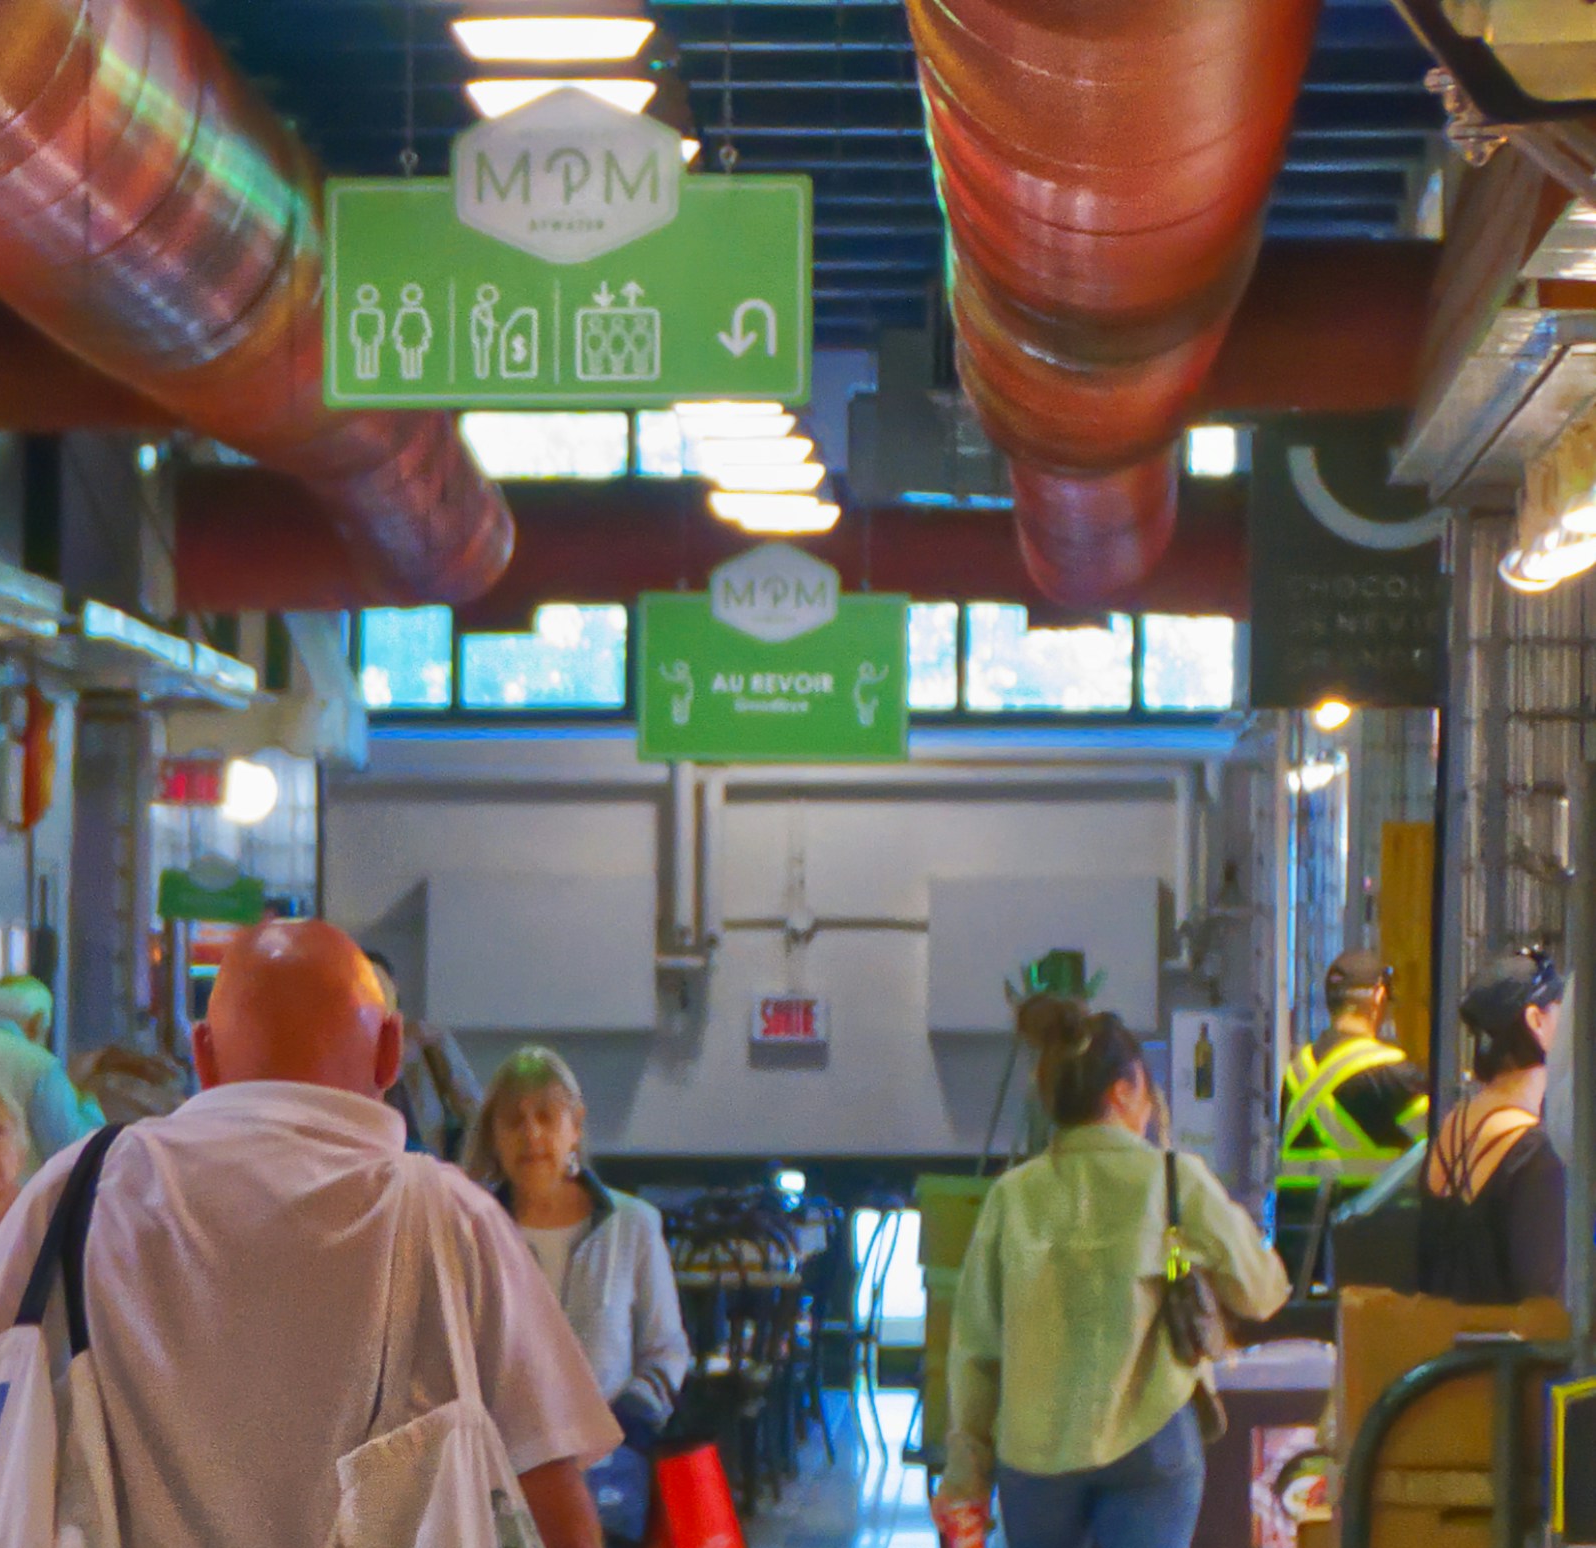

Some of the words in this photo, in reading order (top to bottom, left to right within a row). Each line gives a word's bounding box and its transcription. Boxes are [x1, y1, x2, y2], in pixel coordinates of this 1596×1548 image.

[475, 147, 659, 205] MPM
[722, 575, 828, 609] MPM
[711, 673, 744, 693] AU
[750, 673, 834, 693] REVOIR
